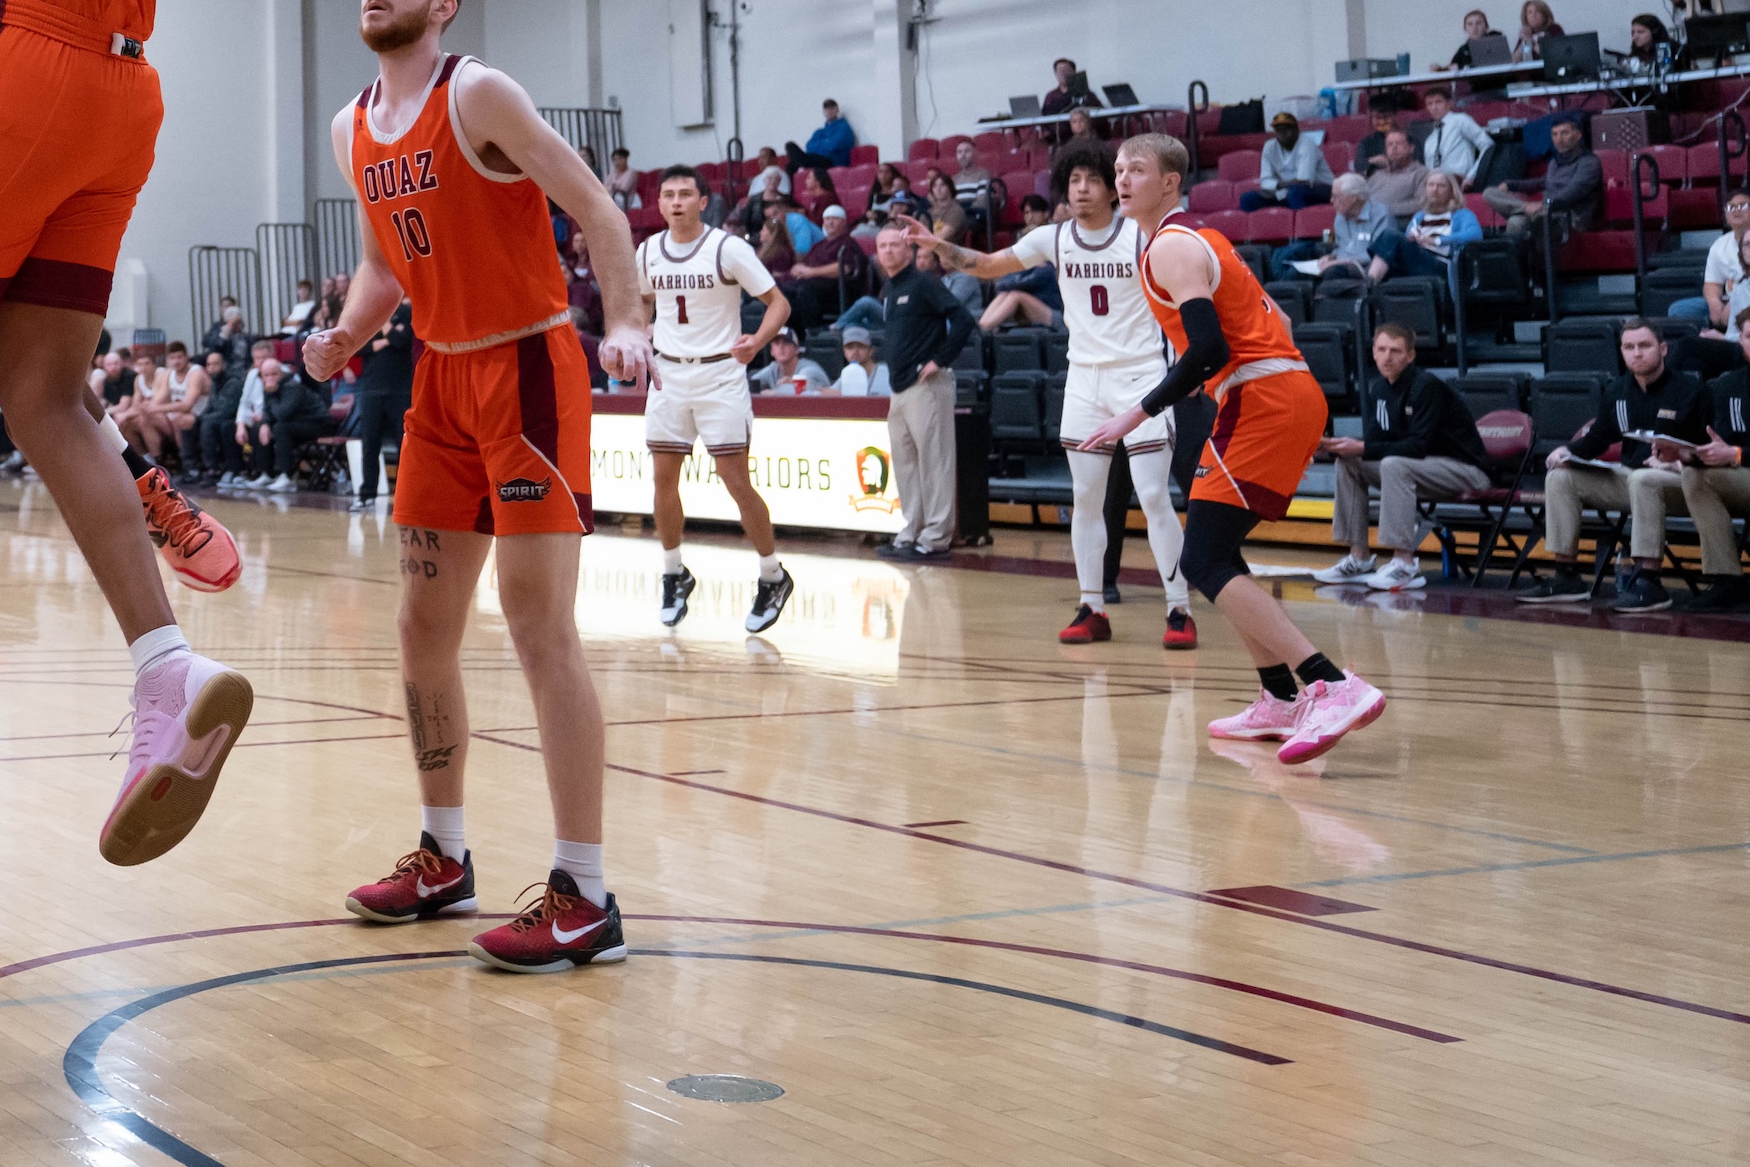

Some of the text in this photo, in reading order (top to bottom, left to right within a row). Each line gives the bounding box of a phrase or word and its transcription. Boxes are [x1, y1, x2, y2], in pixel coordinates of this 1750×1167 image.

[363, 149, 439, 204] OUAZ
[391, 207, 432, 262] 10
[1065, 263, 1133, 278] WARRIORS
[676, 295, 689, 324] 1
[1090, 285, 1109, 316] 0
[592, 449, 831, 491] MON WARIORS
[500, 486, 545, 498] SPIRIT
